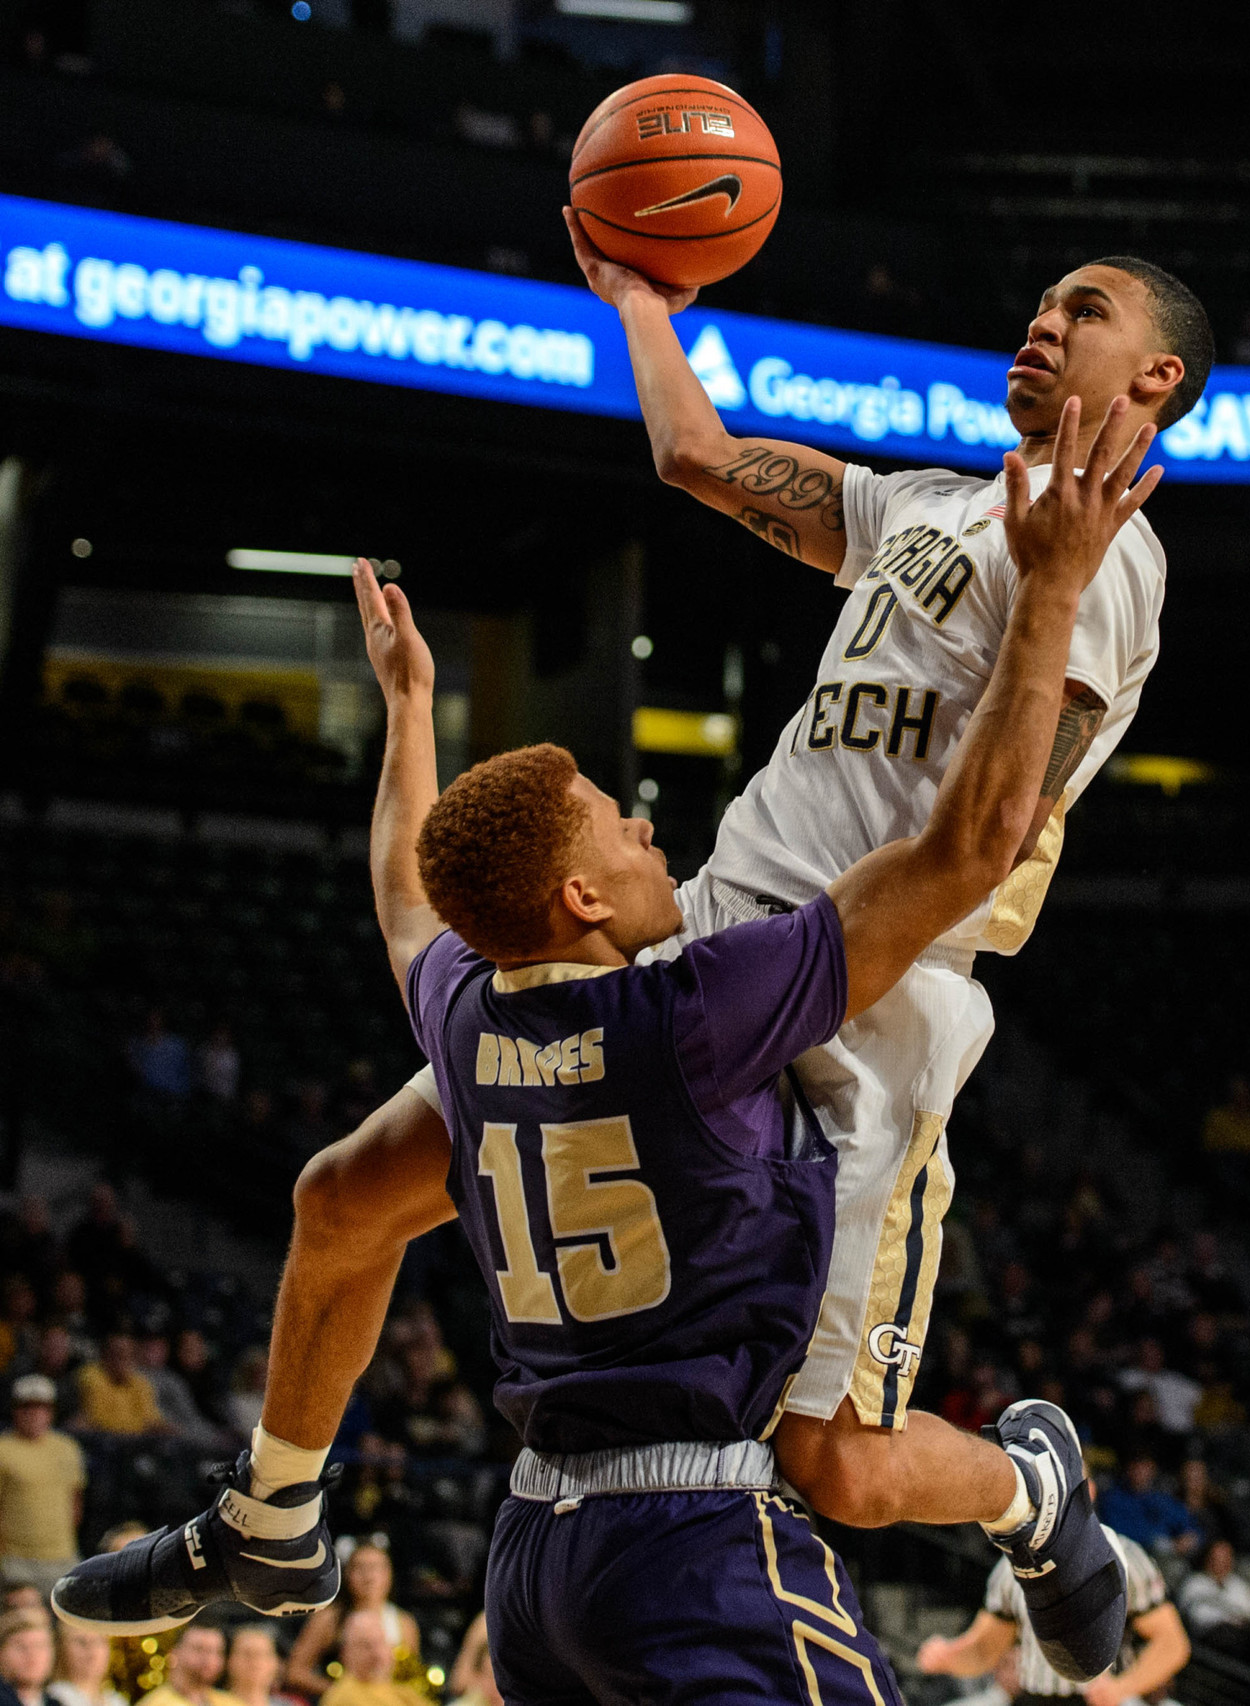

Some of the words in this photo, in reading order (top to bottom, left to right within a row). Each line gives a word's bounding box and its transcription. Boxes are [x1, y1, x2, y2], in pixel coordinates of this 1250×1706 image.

[637, 111, 735, 141] ELITE
[4, 241, 69, 308] at
[74, 256, 594, 389] georgiapower.com
[749, 356, 925, 442] Georgia
[789, 681, 940, 762] ECH
[477, 1114, 672, 1325] 15
[868, 1322, 921, 1377] GT
